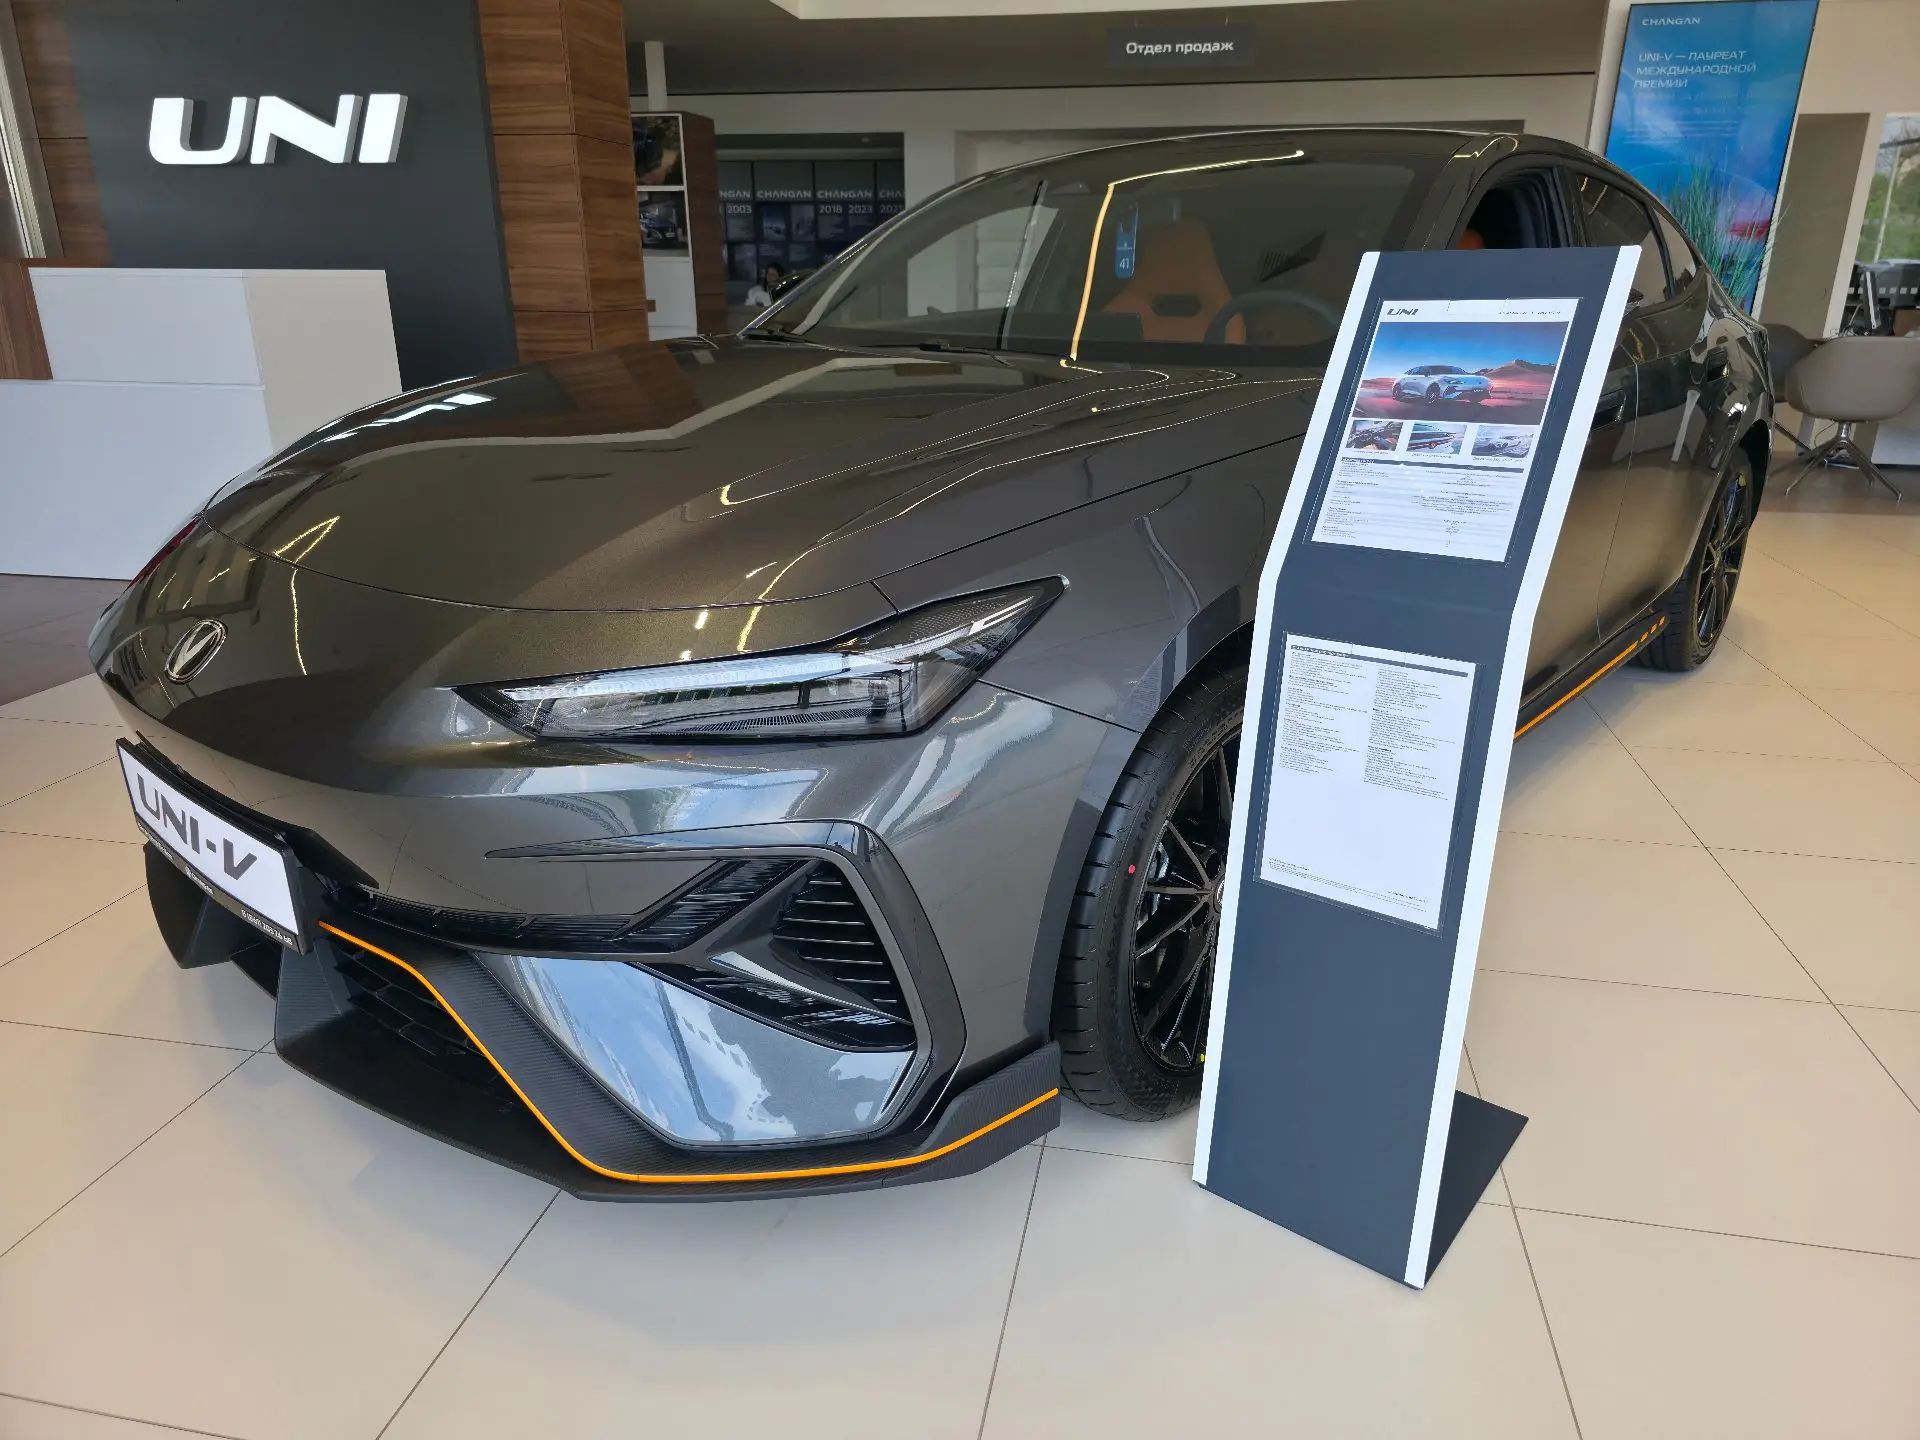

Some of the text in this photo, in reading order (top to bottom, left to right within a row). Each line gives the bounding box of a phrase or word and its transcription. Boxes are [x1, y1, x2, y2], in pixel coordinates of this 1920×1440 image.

[1641, 17, 1700, 26] CHANGAN
[1126, 41, 1234, 55] Отдел продаж
[1638, 52, 1672, 62] UNI-V
[1688, 50, 1747, 61] ЛАУРЕАТ
[1636, 62, 1757, 76] МЕЖДУНАРОДНОЙ
[1633, 79, 1688, 89] ПРЕМИИ
[149, 93, 407, 165] UNI
[756, 189, 812, 199] CHANGAN
[816, 189, 873, 199] CHANGAN
[727, 204, 752, 214] 2003
[1119, 257, 1130, 269] 41
[137, 773, 257, 881] UNI-V
